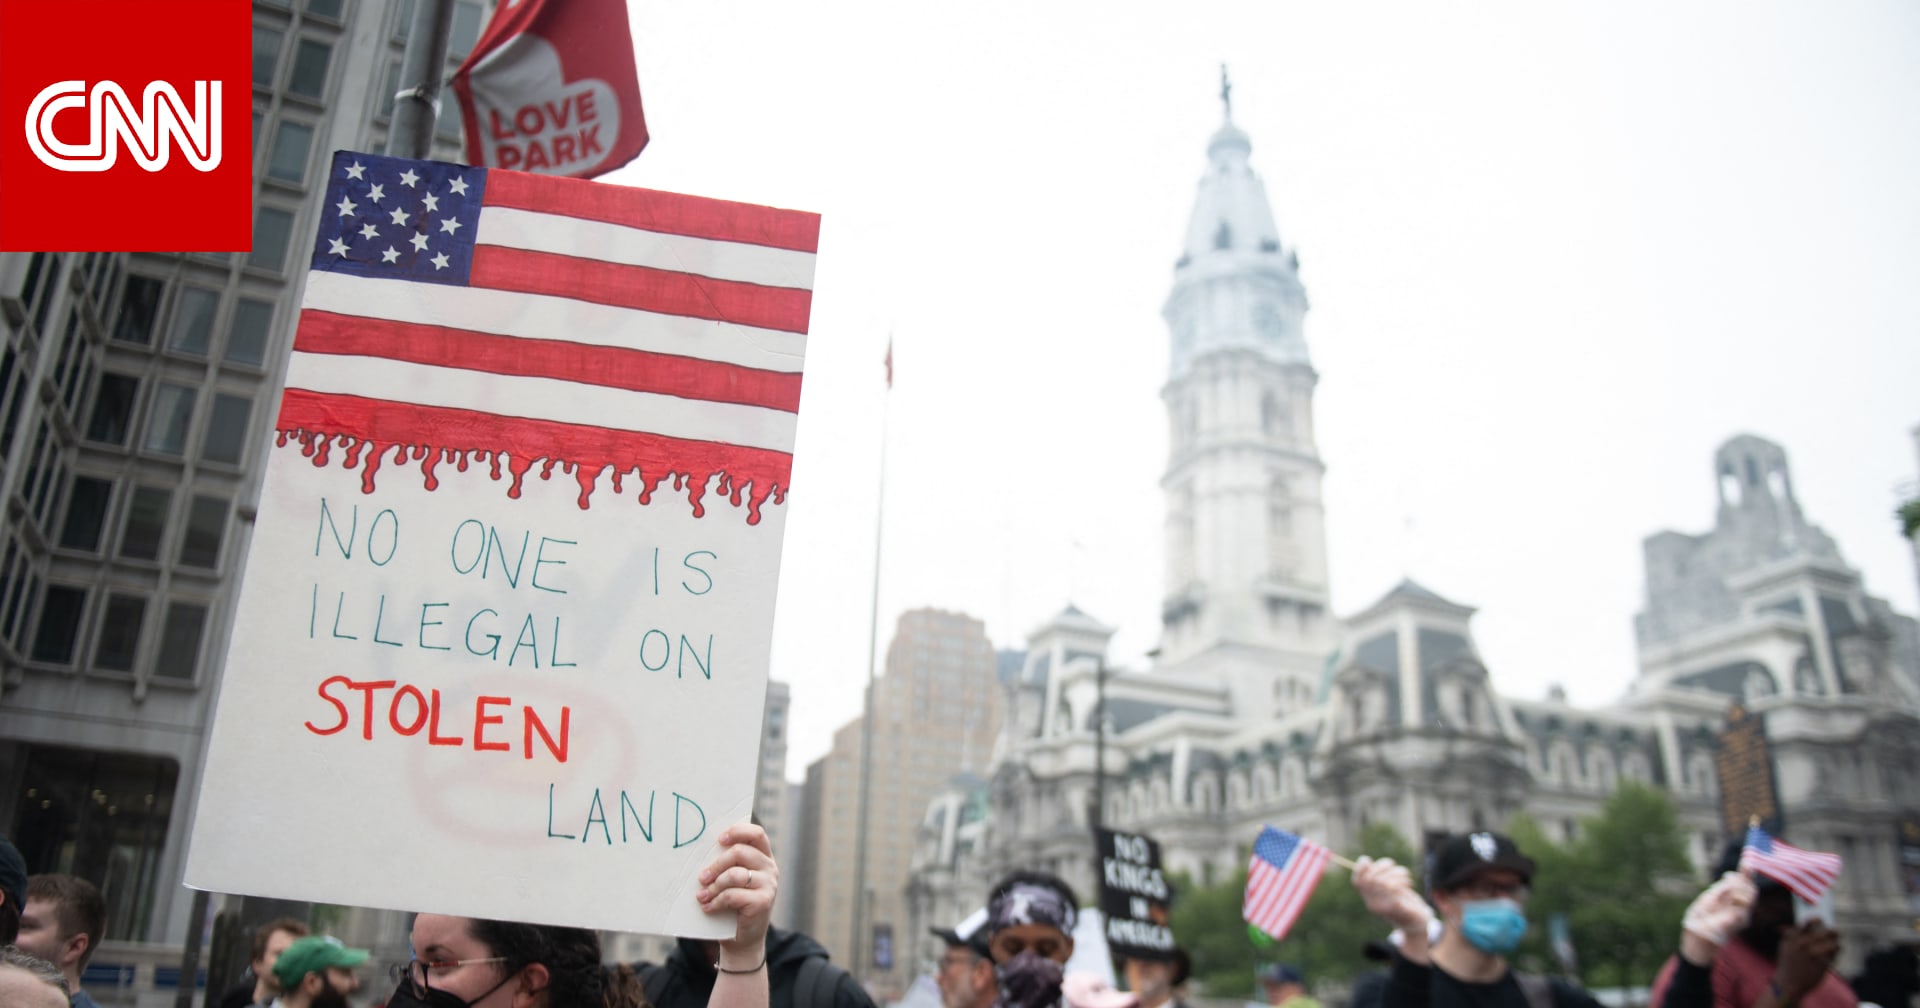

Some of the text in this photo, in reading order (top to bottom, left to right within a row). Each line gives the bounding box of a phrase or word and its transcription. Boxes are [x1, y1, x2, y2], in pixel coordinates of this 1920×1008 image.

[488, 89, 599, 141] LOVE
[495, 122, 604, 172] PARK
[315, 497, 718, 596] NO ONE IS
[310, 583, 713, 680] ILLEGAL ON
[304, 675, 571, 763] STOLEN
[547, 783, 707, 849] LAND
[1103, 856, 1169, 899] KINGS
[1113, 833, 1151, 865] NO
